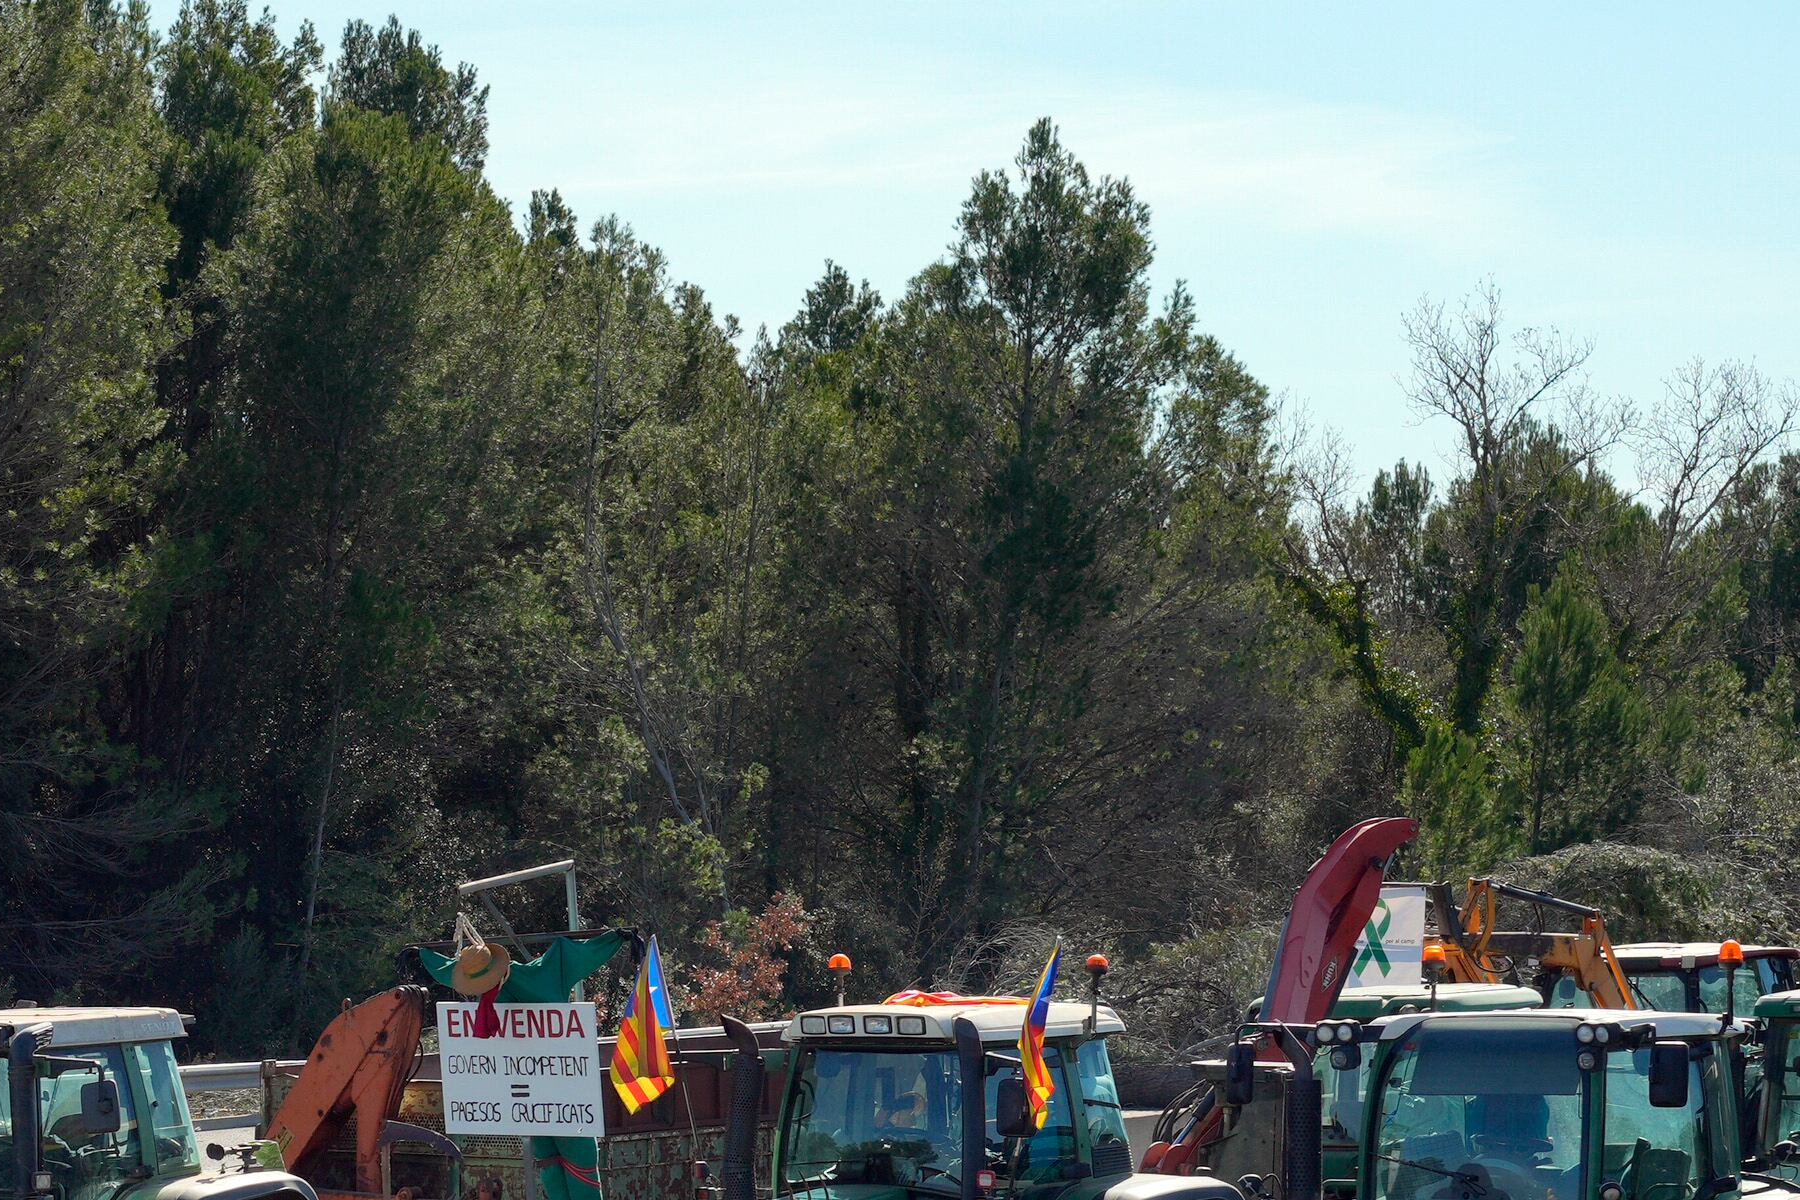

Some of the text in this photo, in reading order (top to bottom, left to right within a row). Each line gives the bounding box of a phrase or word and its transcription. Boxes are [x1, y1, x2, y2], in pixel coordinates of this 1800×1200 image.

[449, 1055, 589, 1077] GOVERN INCOMPETENT
[451, 1101, 595, 1124] PAGESOS CRUCIFICATS
